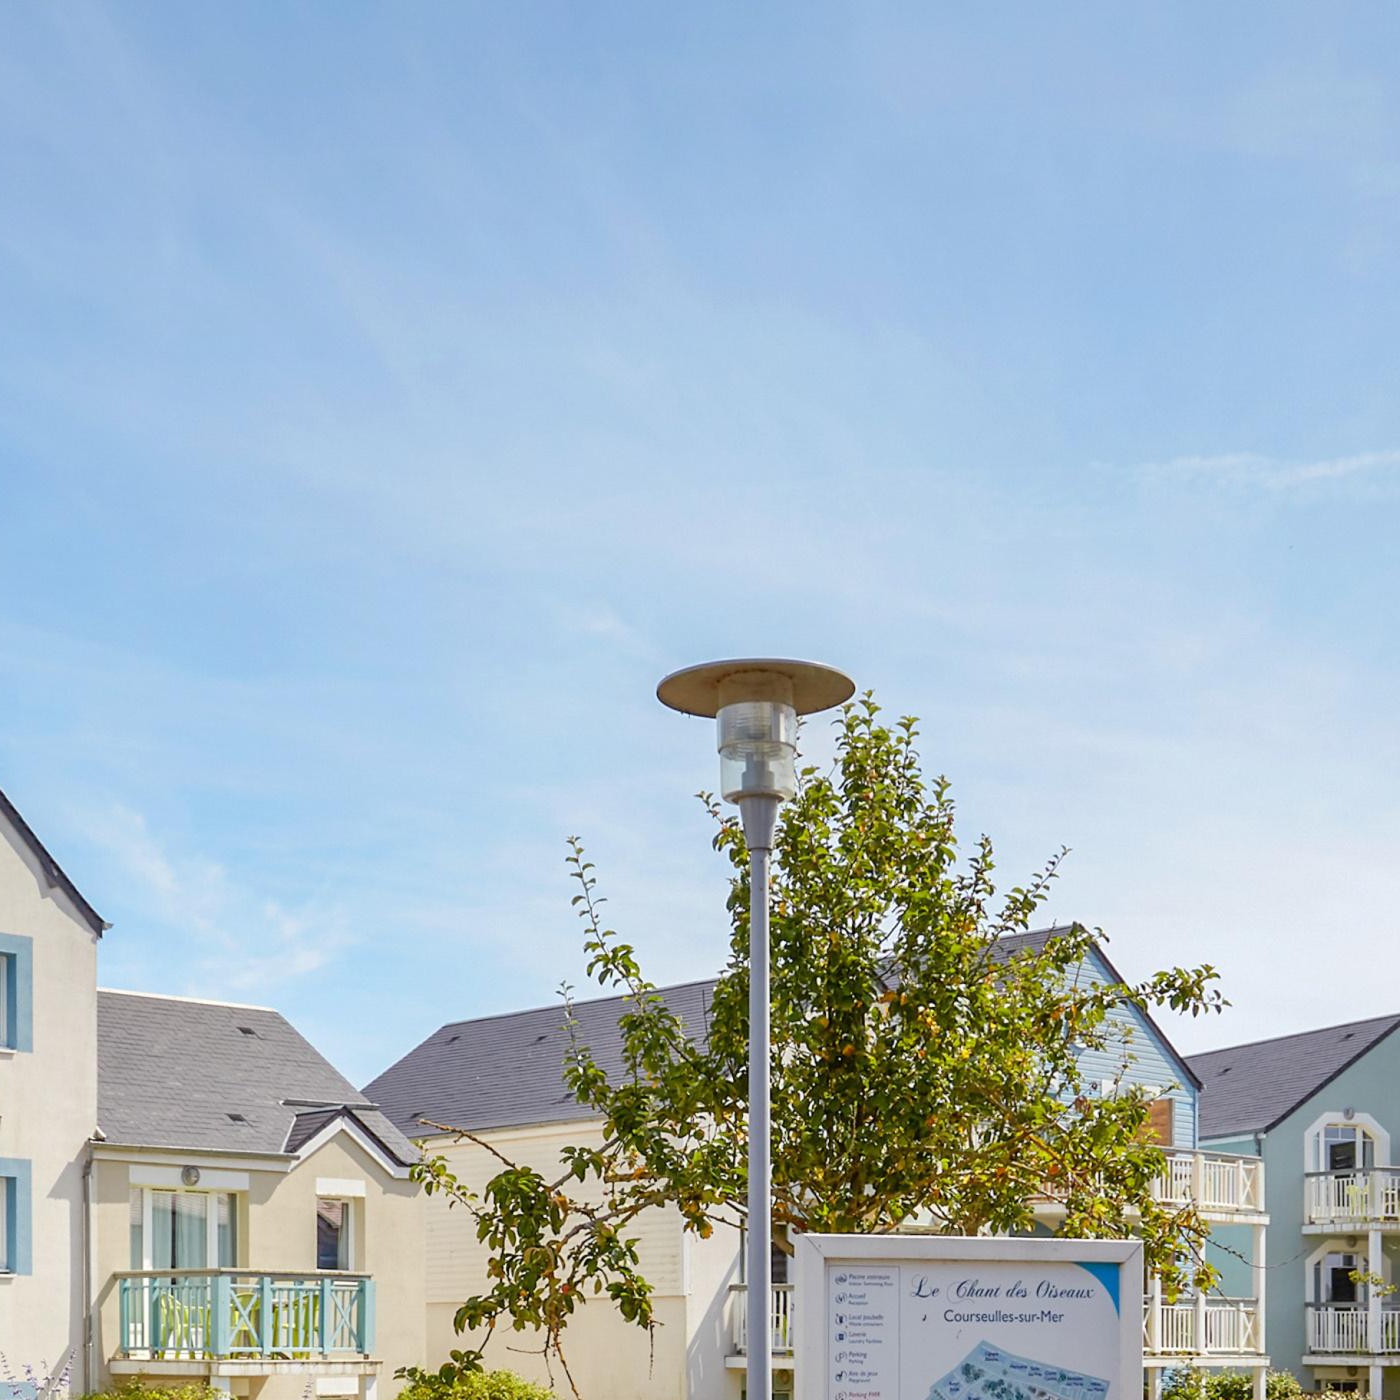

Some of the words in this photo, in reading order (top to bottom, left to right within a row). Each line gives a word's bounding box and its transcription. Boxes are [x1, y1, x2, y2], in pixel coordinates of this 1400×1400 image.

[912, 1274, 940, 1298] Le
[947, 1279, 1000, 1304] Chant
[1005, 1280, 1028, 1298] des
[1036, 1279, 1095, 1299] Oiseaux
[943, 1309, 1065, 1323] Courseulles-sur-Mer
[849, 1351, 867, 1359] Parking
